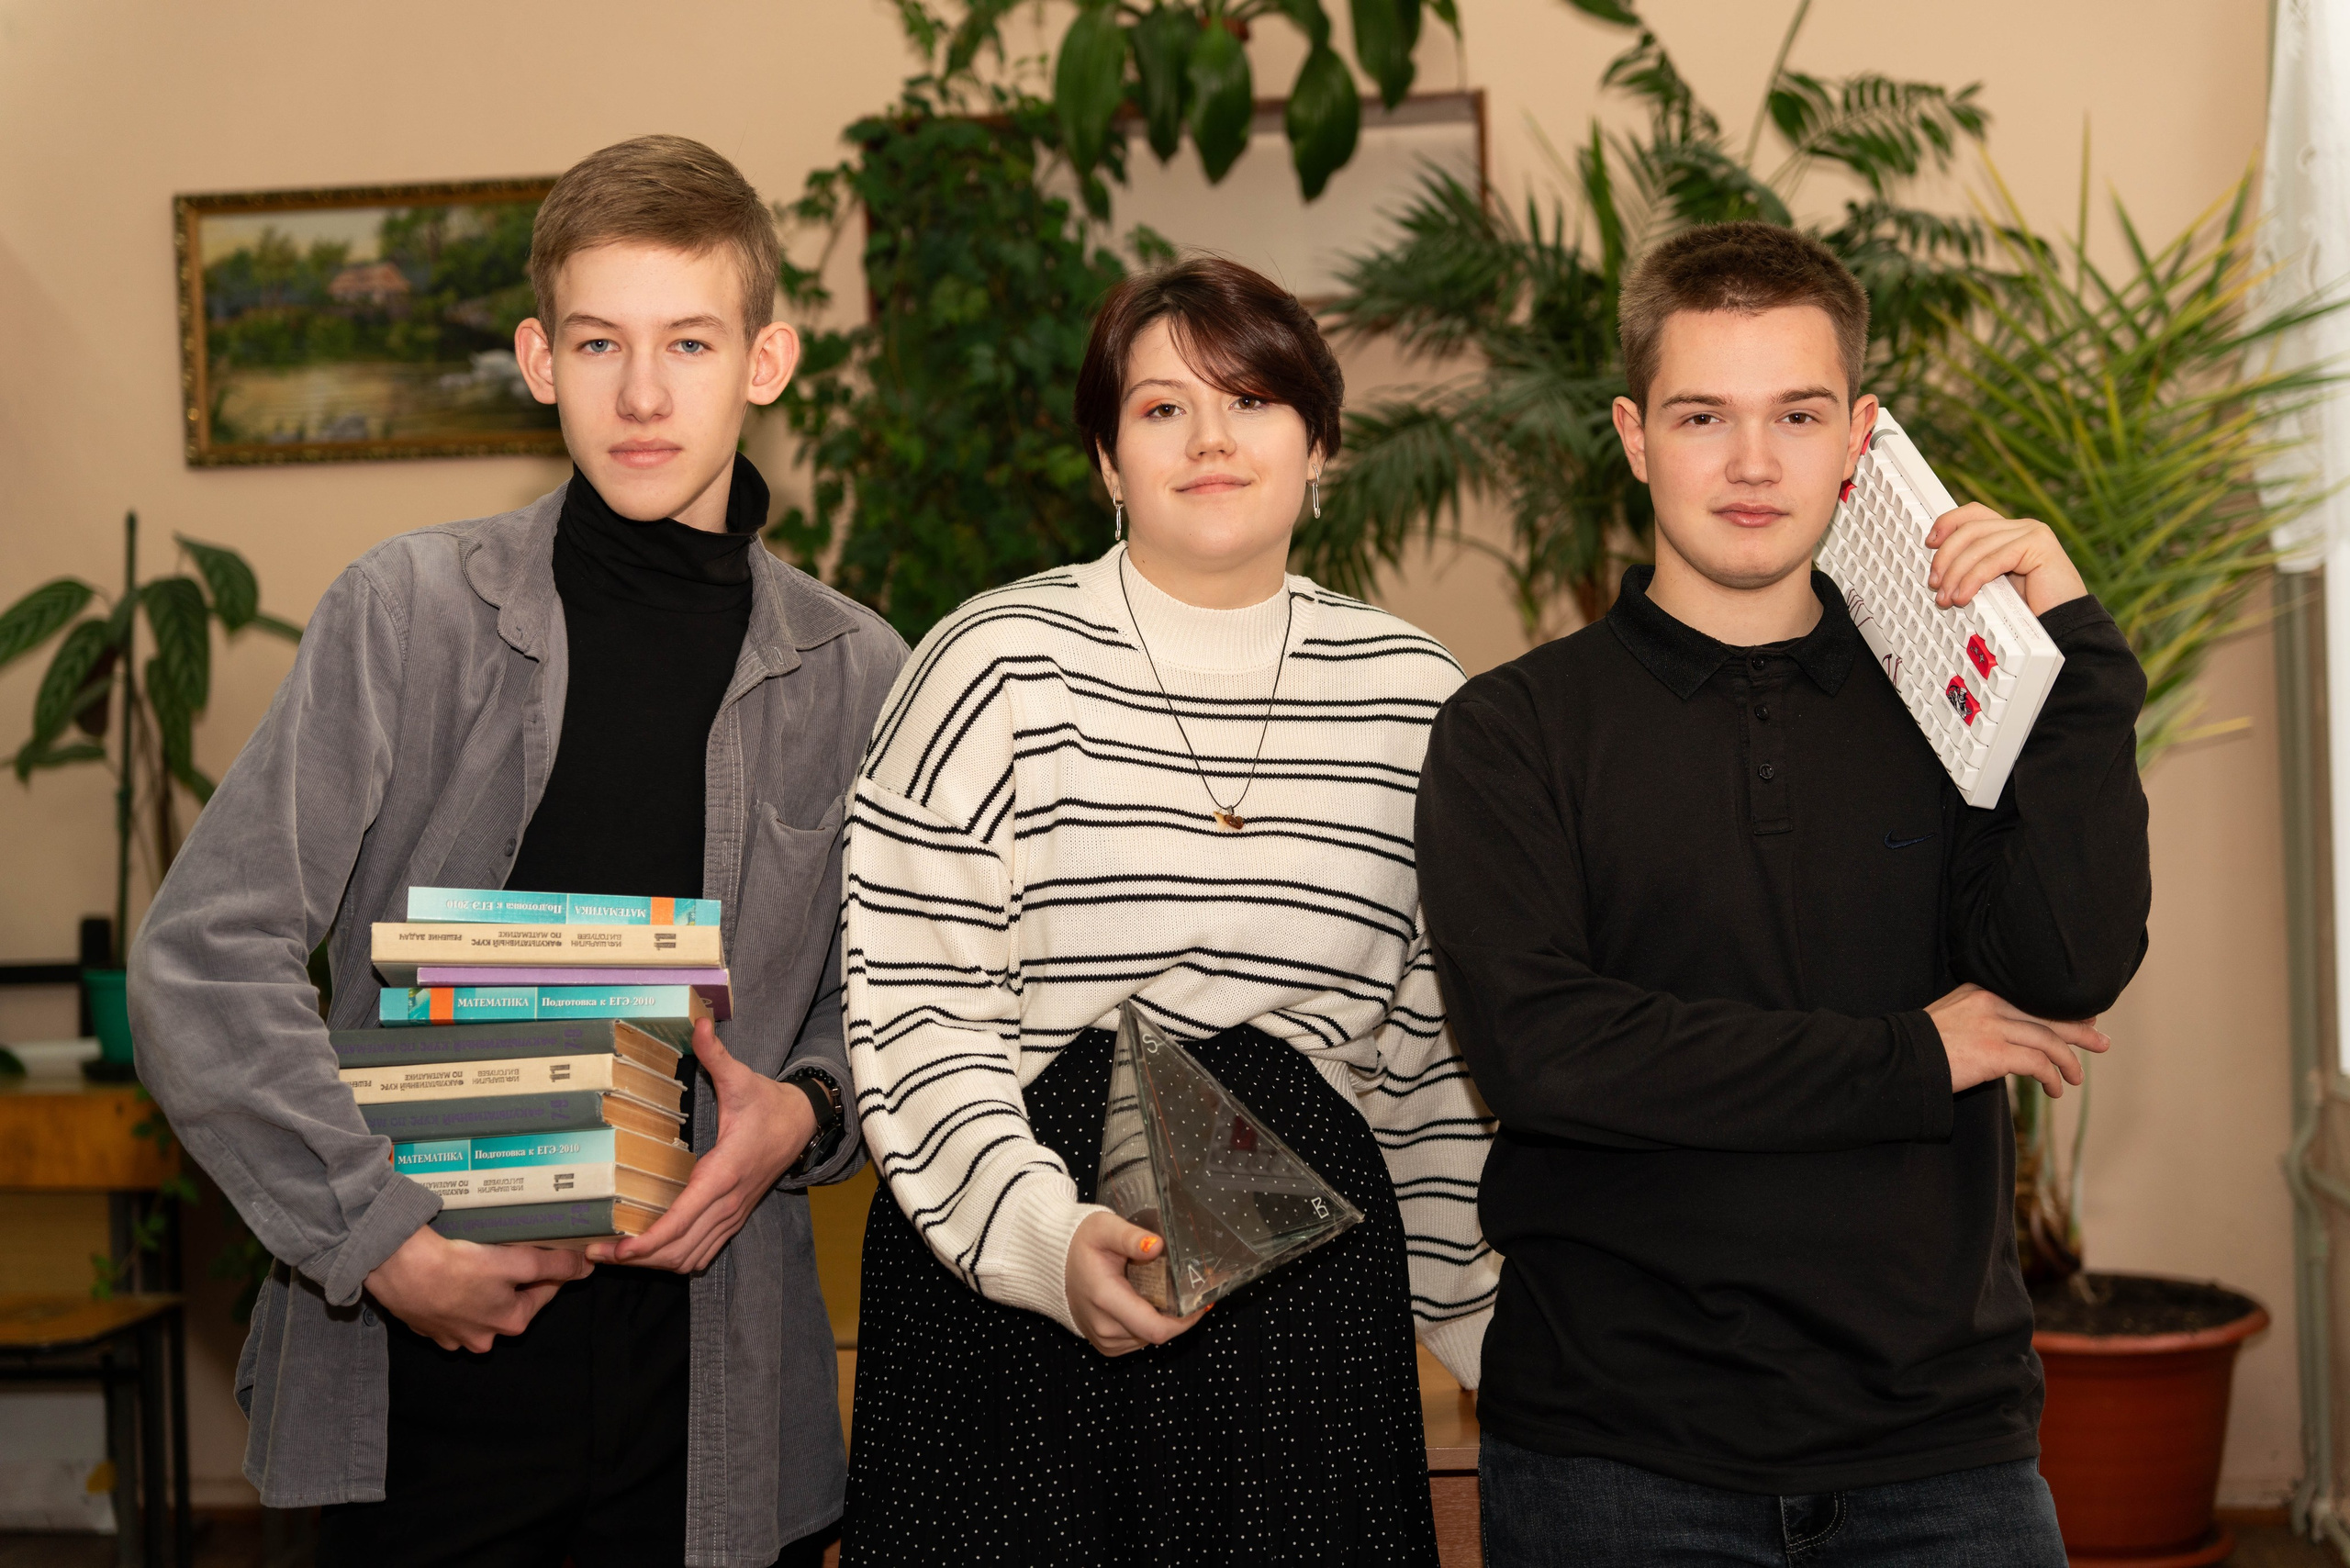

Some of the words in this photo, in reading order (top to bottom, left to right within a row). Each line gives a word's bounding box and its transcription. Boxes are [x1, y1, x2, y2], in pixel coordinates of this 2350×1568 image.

[506, 902, 562, 913] Подготовка
[575, 906, 645, 917] МАТЕМАТИКА
[399, 934, 425, 942] ЗАДАЧ
[492, 940, 562, 948] ФАКУЛЬТАТИВНЫЙ
[458, 998, 529, 1008] МАТЕМАТИКА
[542, 997, 596, 1007] Подготовка
[610, 996, 655, 1006] ЕГЭ-2010
[1142, 1034, 1159, 1055] S
[405, 1072, 450, 1081] МАТЕМАТИКЕ
[381, 1082, 397, 1091] КУРС
[399, 1079, 464, 1091] ФАКУЛЬТАТИВНЫЙ
[475, 1148, 525, 1159] Подготовка
[528, 1148, 534, 1157] к
[537, 1144, 579, 1155] ЕГЭ-2010
[398, 1152, 463, 1165] МАТЕМАТИКА
